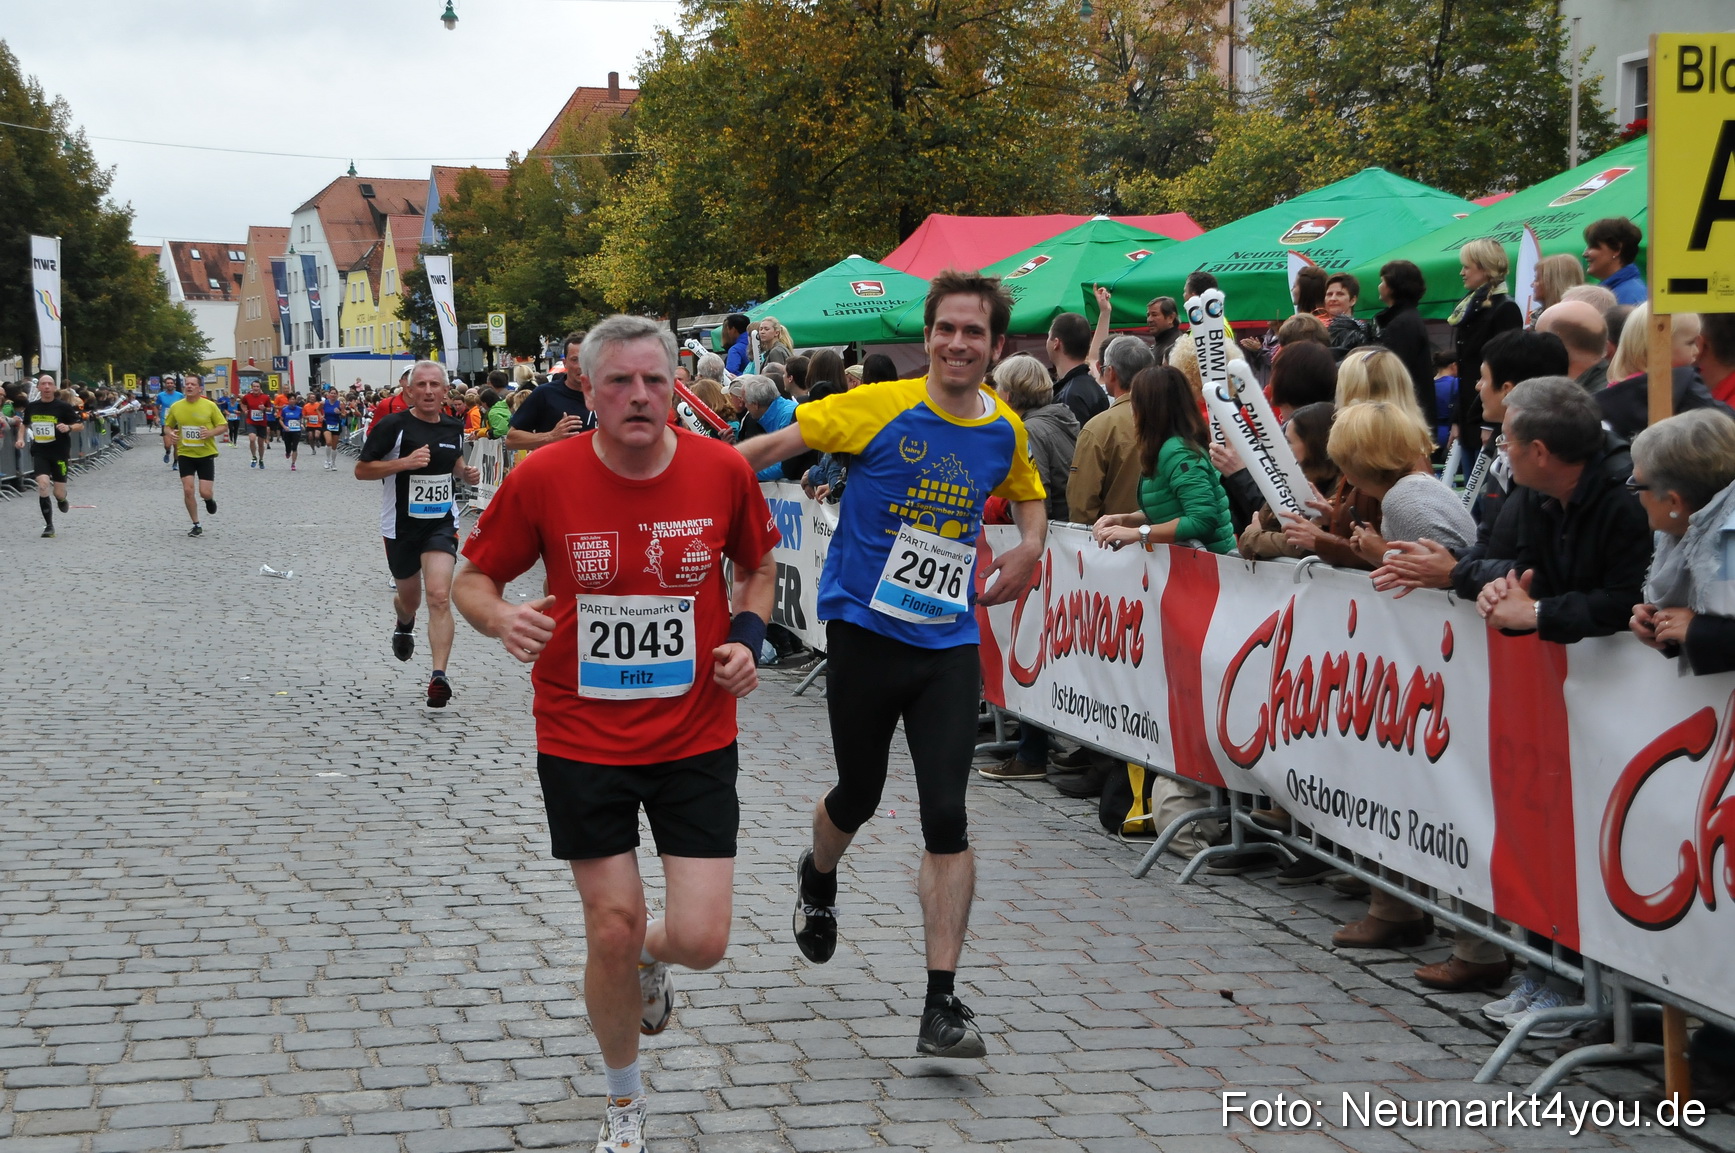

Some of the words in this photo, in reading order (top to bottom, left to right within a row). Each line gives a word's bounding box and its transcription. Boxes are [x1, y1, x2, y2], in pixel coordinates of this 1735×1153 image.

[1227, 248, 1344, 260] Neumakter
[1195, 257, 1351, 273] Lammsäu
[1208, 329, 1226, 373] BMW
[35, 426, 51, 436] 615
[185, 430, 200, 439] 603
[904, 447, 921, 455] Jahre
[1258, 455, 1304, 517] Laufspo
[1462, 453, 1488, 508] w-laufspor
[414, 485, 449, 502] 2458
[423, 505, 442, 513] Alfons
[638, 523, 652, 532] 11.
[653, 517, 714, 530] NEUMARKTER
[652, 527, 704, 539] STADTLAUF
[572, 540, 610, 551] IMMER
[899, 532, 930, 552] PARTL
[930, 544, 964, 562] Neumarkt
[572, 549, 612, 560] WIEDER
[575, 558, 610, 573] NEU
[577, 571, 610, 581] MARKT
[893, 550, 964, 599] 2916
[771, 561, 807, 631] ER
[580, 603, 617, 616] PARTL
[619, 604, 675, 616] Neumarkt
[900, 593, 943, 617] Florian
[1008, 547, 1146, 688] Charivari
[590, 618, 684, 660] 2043
[620, 670, 654, 685] Fritz
[1217, 594, 1451, 770] Charivari
[1051, 680, 1117, 729] Ostbayerns
[1121, 703, 1159, 745] Radio
[1287, 767, 1401, 842] Ostbayerns
[1407, 808, 1469, 870] Radio
